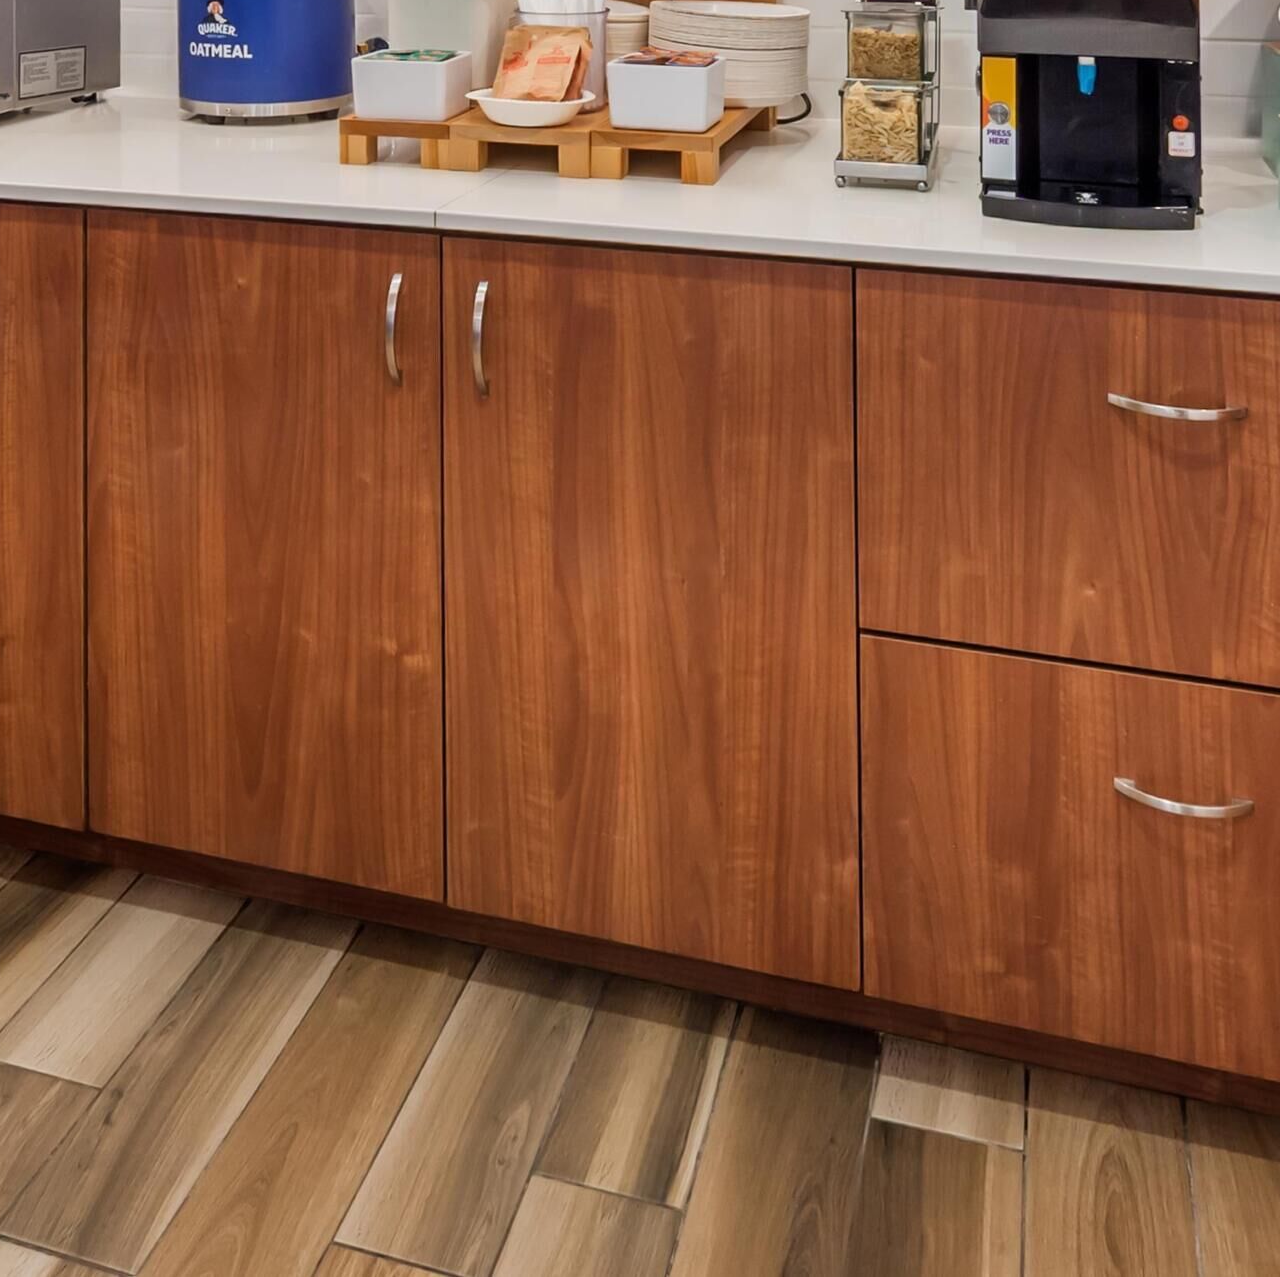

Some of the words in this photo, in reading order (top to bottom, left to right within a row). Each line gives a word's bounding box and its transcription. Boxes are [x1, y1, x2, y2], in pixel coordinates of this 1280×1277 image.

[197, 22, 237, 37] QUAKER
[189, 41, 253, 59] OATMEAL
[986, 128, 1012, 137] PRESS
[988, 137, 1010, 145] HERE
